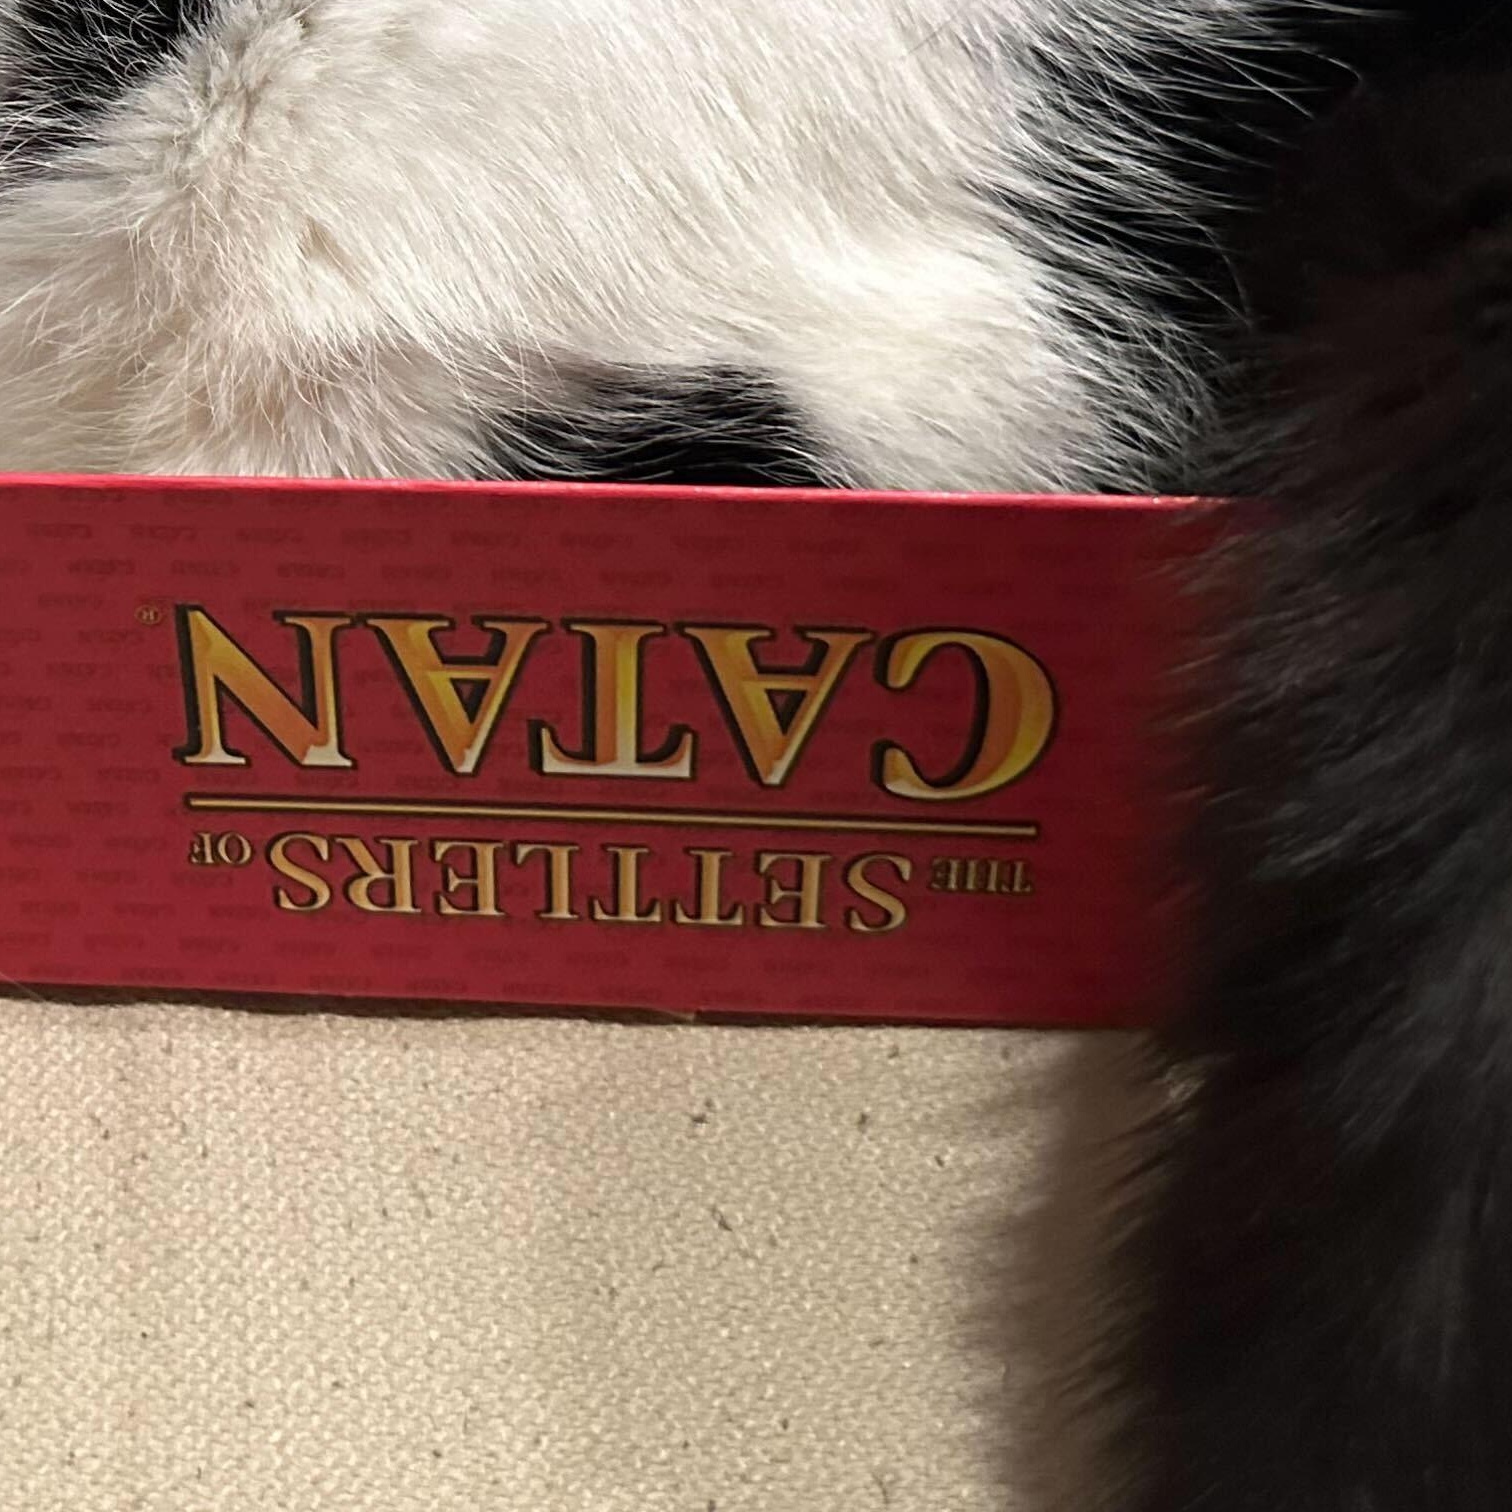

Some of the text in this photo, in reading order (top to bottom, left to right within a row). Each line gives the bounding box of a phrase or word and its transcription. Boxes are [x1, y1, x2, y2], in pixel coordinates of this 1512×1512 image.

[177, 604, 1057, 801] CATAN
[190, 831, 1033, 933] THE SETTLERS OF
